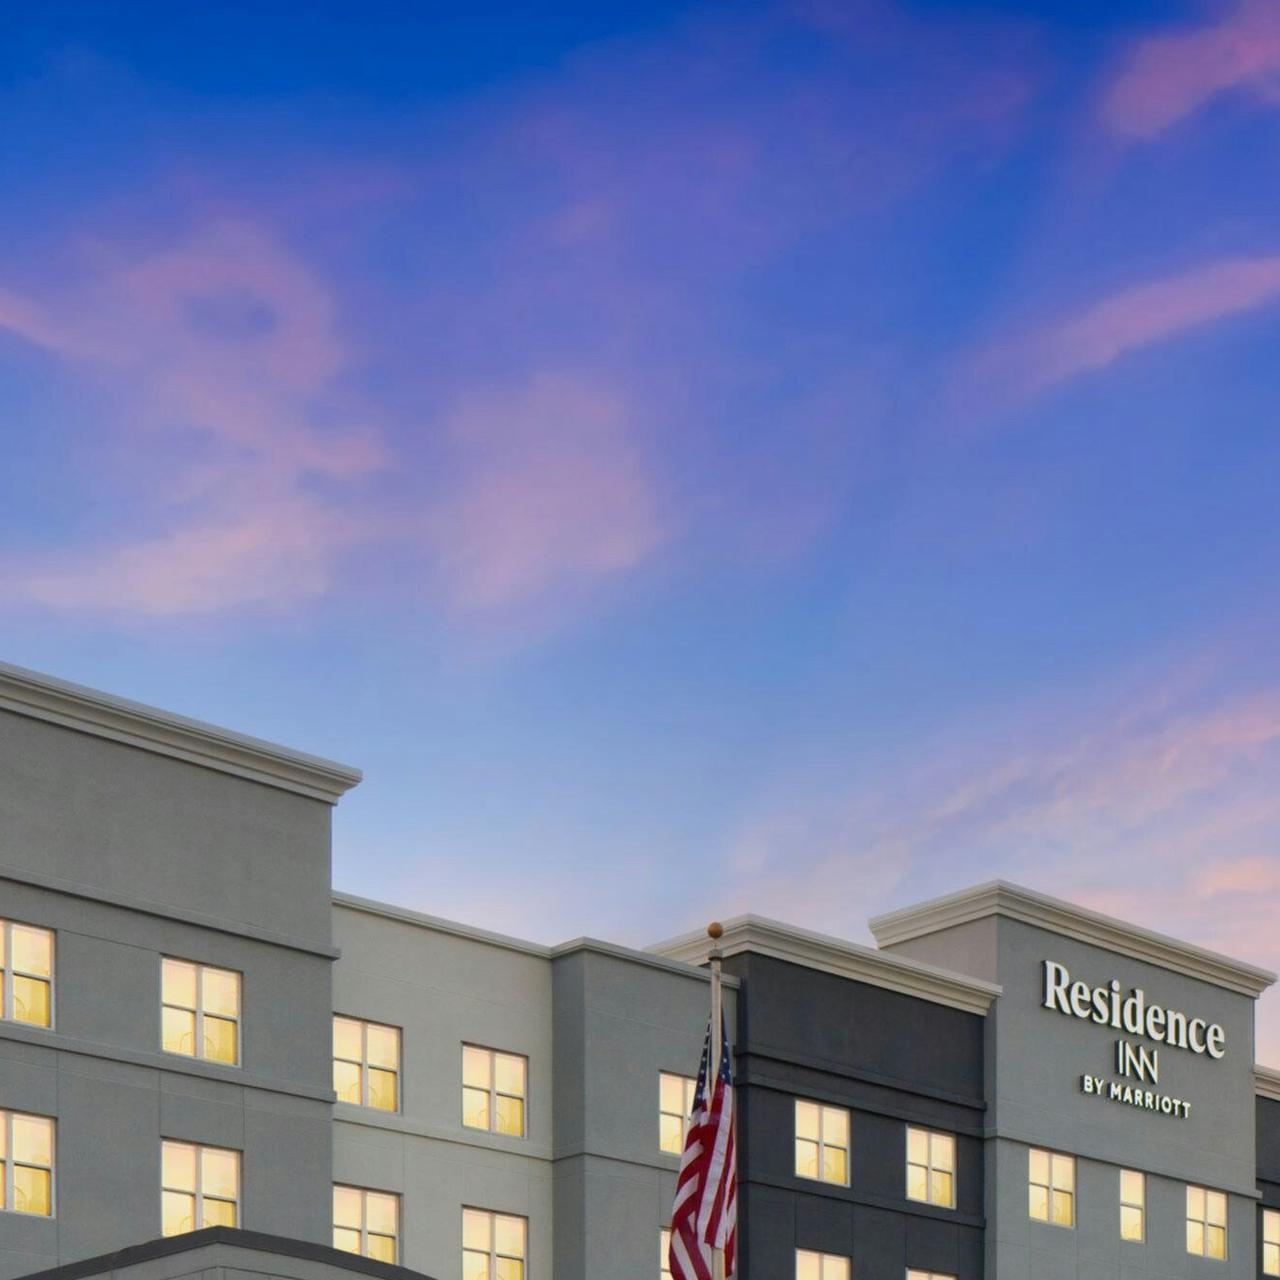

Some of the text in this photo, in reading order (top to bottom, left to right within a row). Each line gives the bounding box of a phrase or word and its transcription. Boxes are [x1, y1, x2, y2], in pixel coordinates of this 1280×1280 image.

[1043, 959, 1226, 1059] Residence
[1117, 1039, 1158, 1084] INN
[1082, 1074, 1192, 1119] BY MARRIOTT
